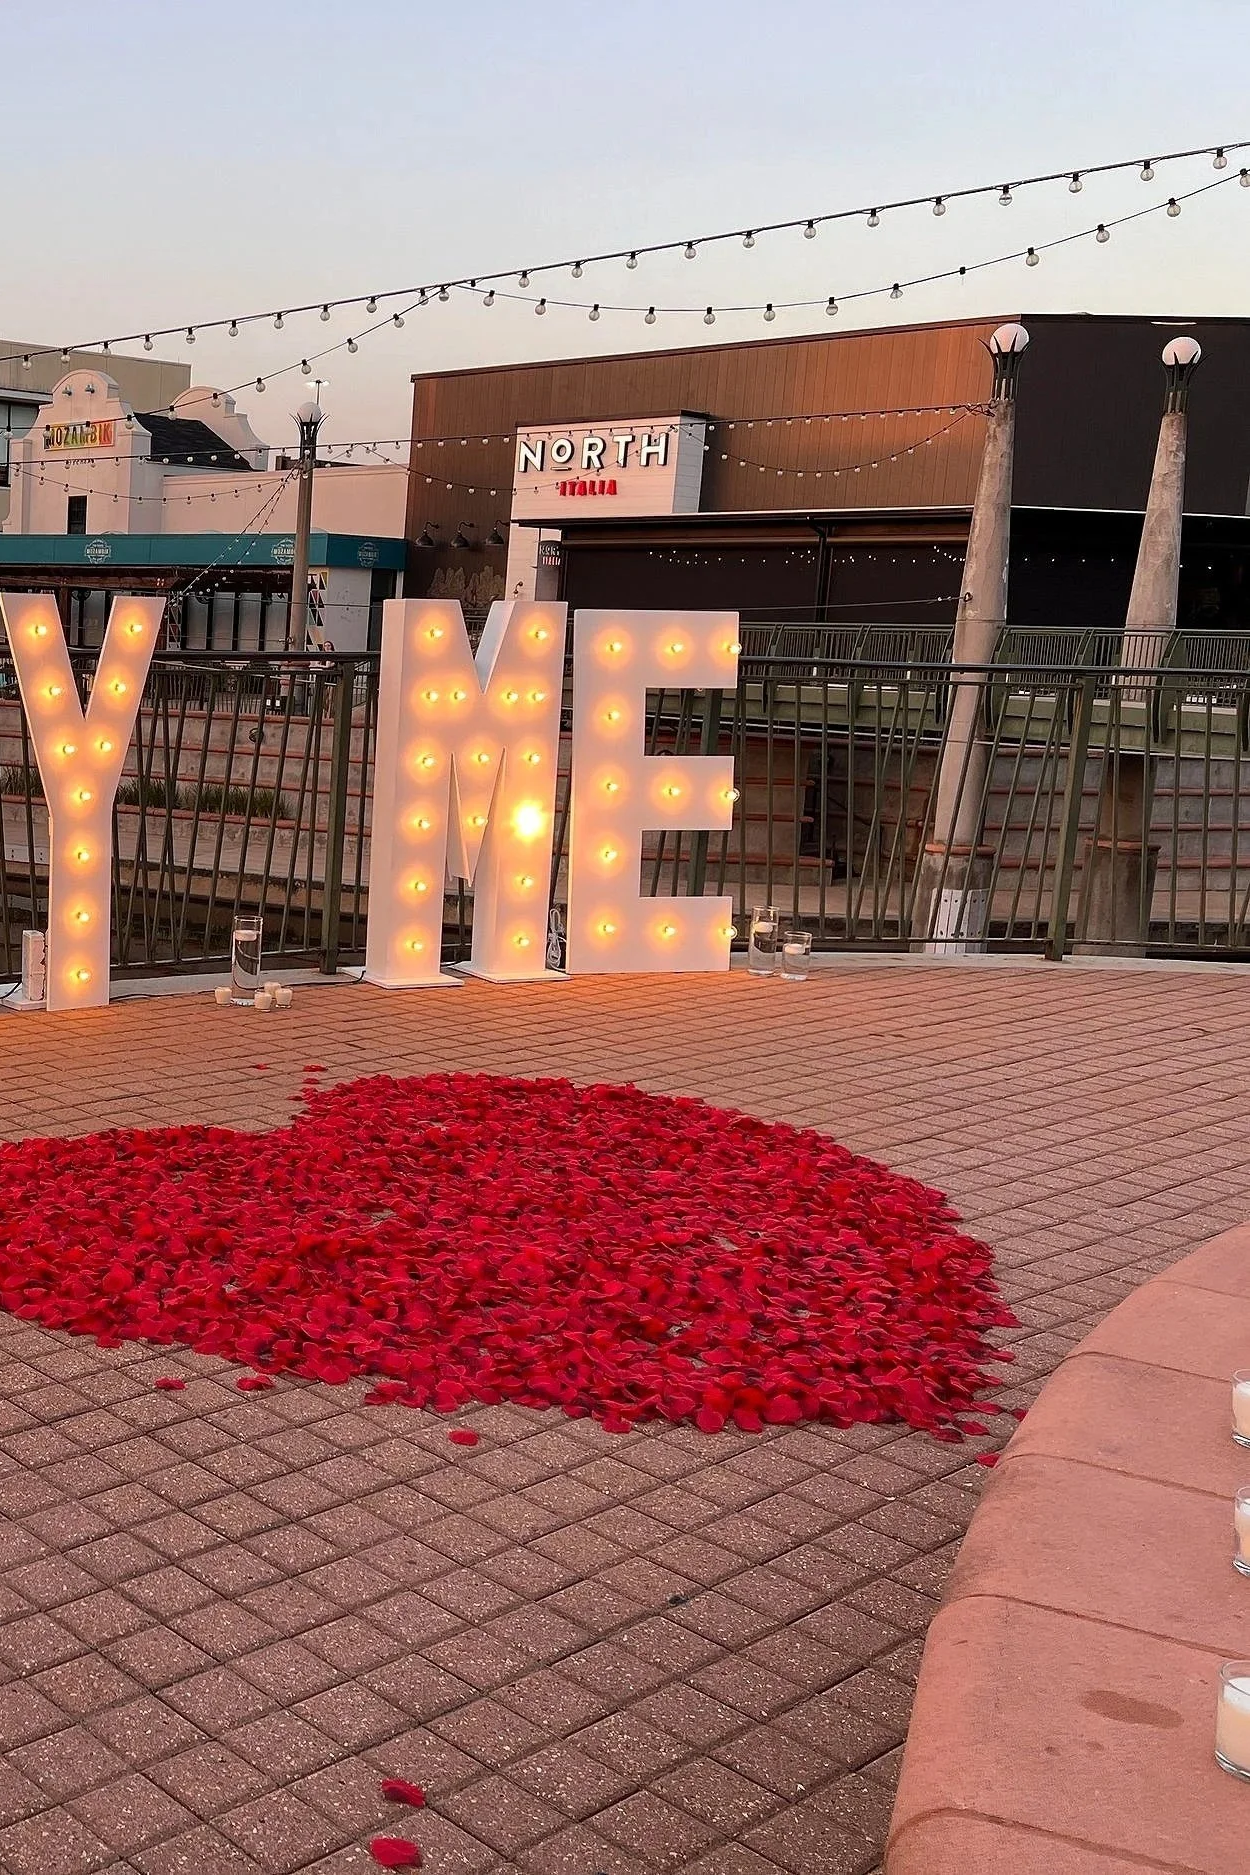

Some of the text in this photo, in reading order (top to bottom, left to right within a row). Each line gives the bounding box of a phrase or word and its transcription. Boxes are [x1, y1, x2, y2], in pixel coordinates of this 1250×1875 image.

[44, 422, 114, 449] MOZAMBIK
[517, 432, 670, 473] NORTH
[559, 479, 618, 497] ITALIA
[366, 599, 740, 983] ME
